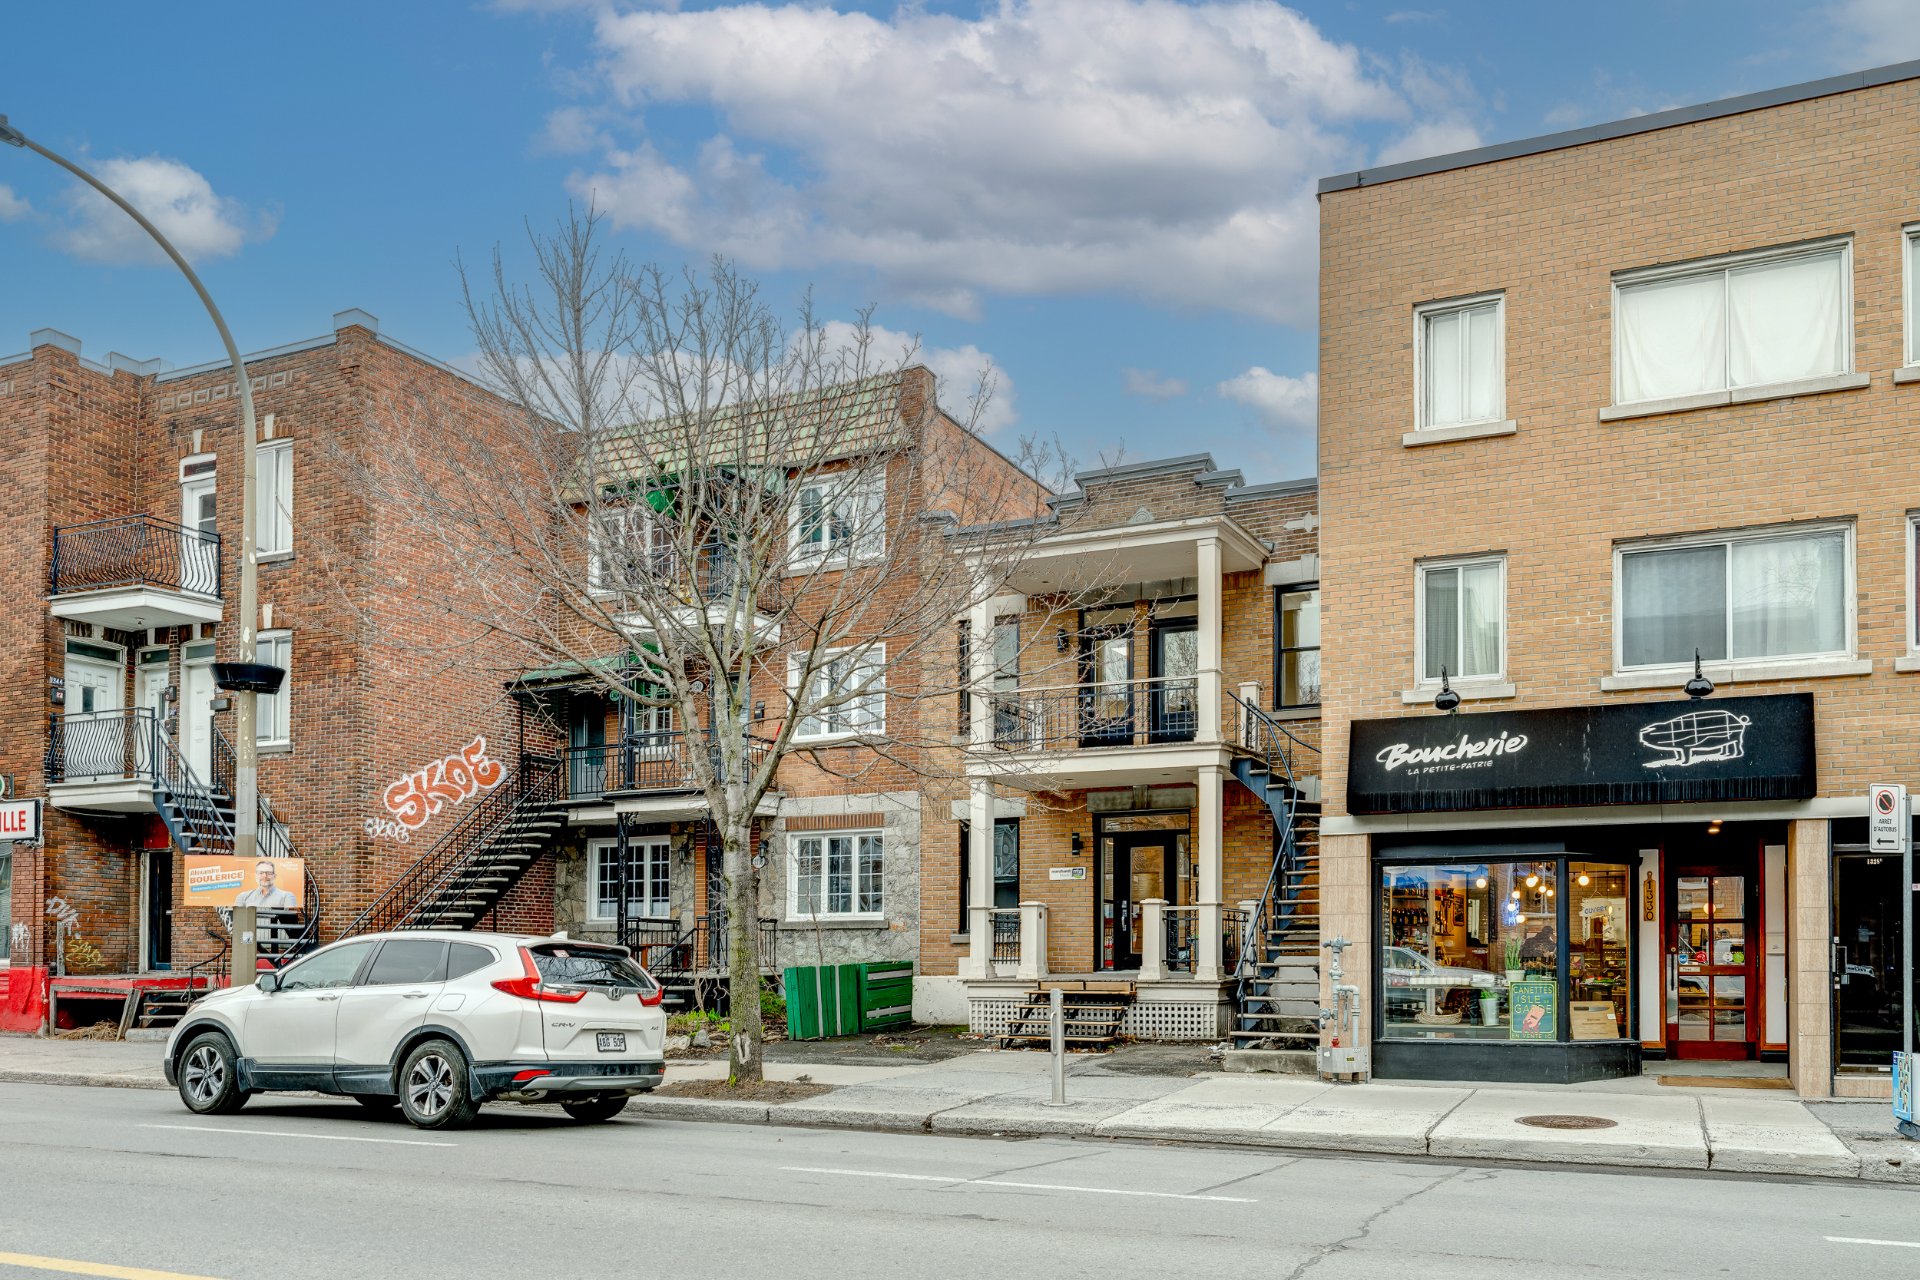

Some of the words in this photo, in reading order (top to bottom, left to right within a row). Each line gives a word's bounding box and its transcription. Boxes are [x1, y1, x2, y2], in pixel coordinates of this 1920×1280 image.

[1375, 730, 1528, 771] Boucherie
[1407, 767, 1420, 776] LA
[1423, 760, 1493, 774] PETITE-PATRIE
[190, 871, 243, 884] BOULERICE
[1645, 881, 1654, 921] 1330
[1513, 986, 1553, 994] CANETTES
[1517, 995, 1541, 1004] ISLE
